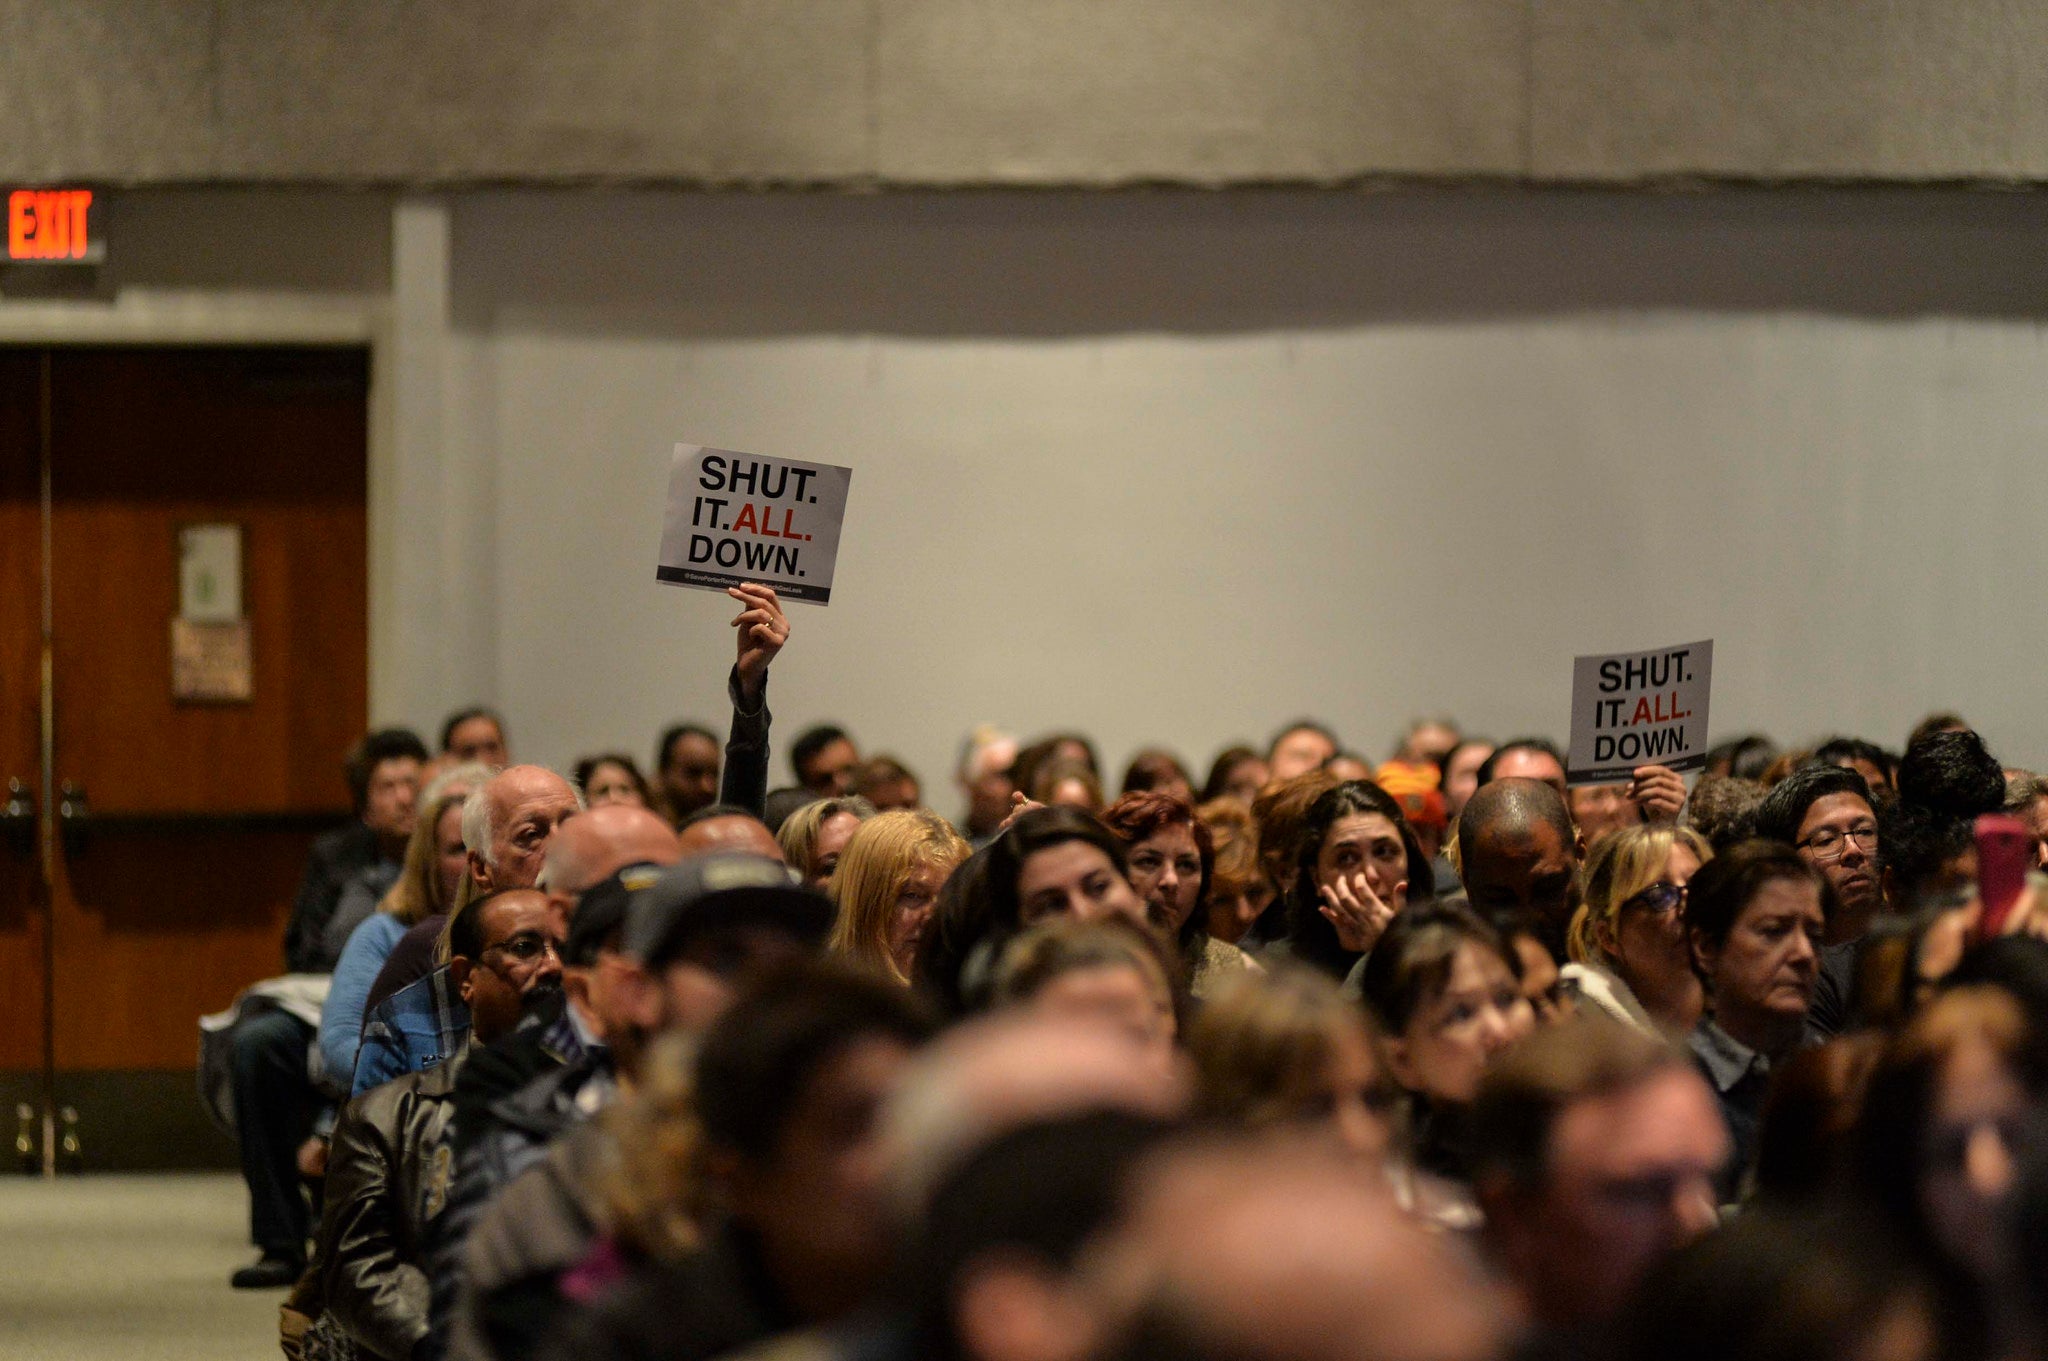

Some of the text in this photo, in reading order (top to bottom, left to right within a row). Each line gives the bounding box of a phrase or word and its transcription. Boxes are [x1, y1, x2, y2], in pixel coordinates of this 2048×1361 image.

[9, 190, 92, 260] EXIT
[699, 455, 817, 503] SHUT.
[688, 534, 805, 577] DOWN.
[1599, 650, 1692, 692] SHUT.
[1594, 725, 1689, 762] DOWN.
